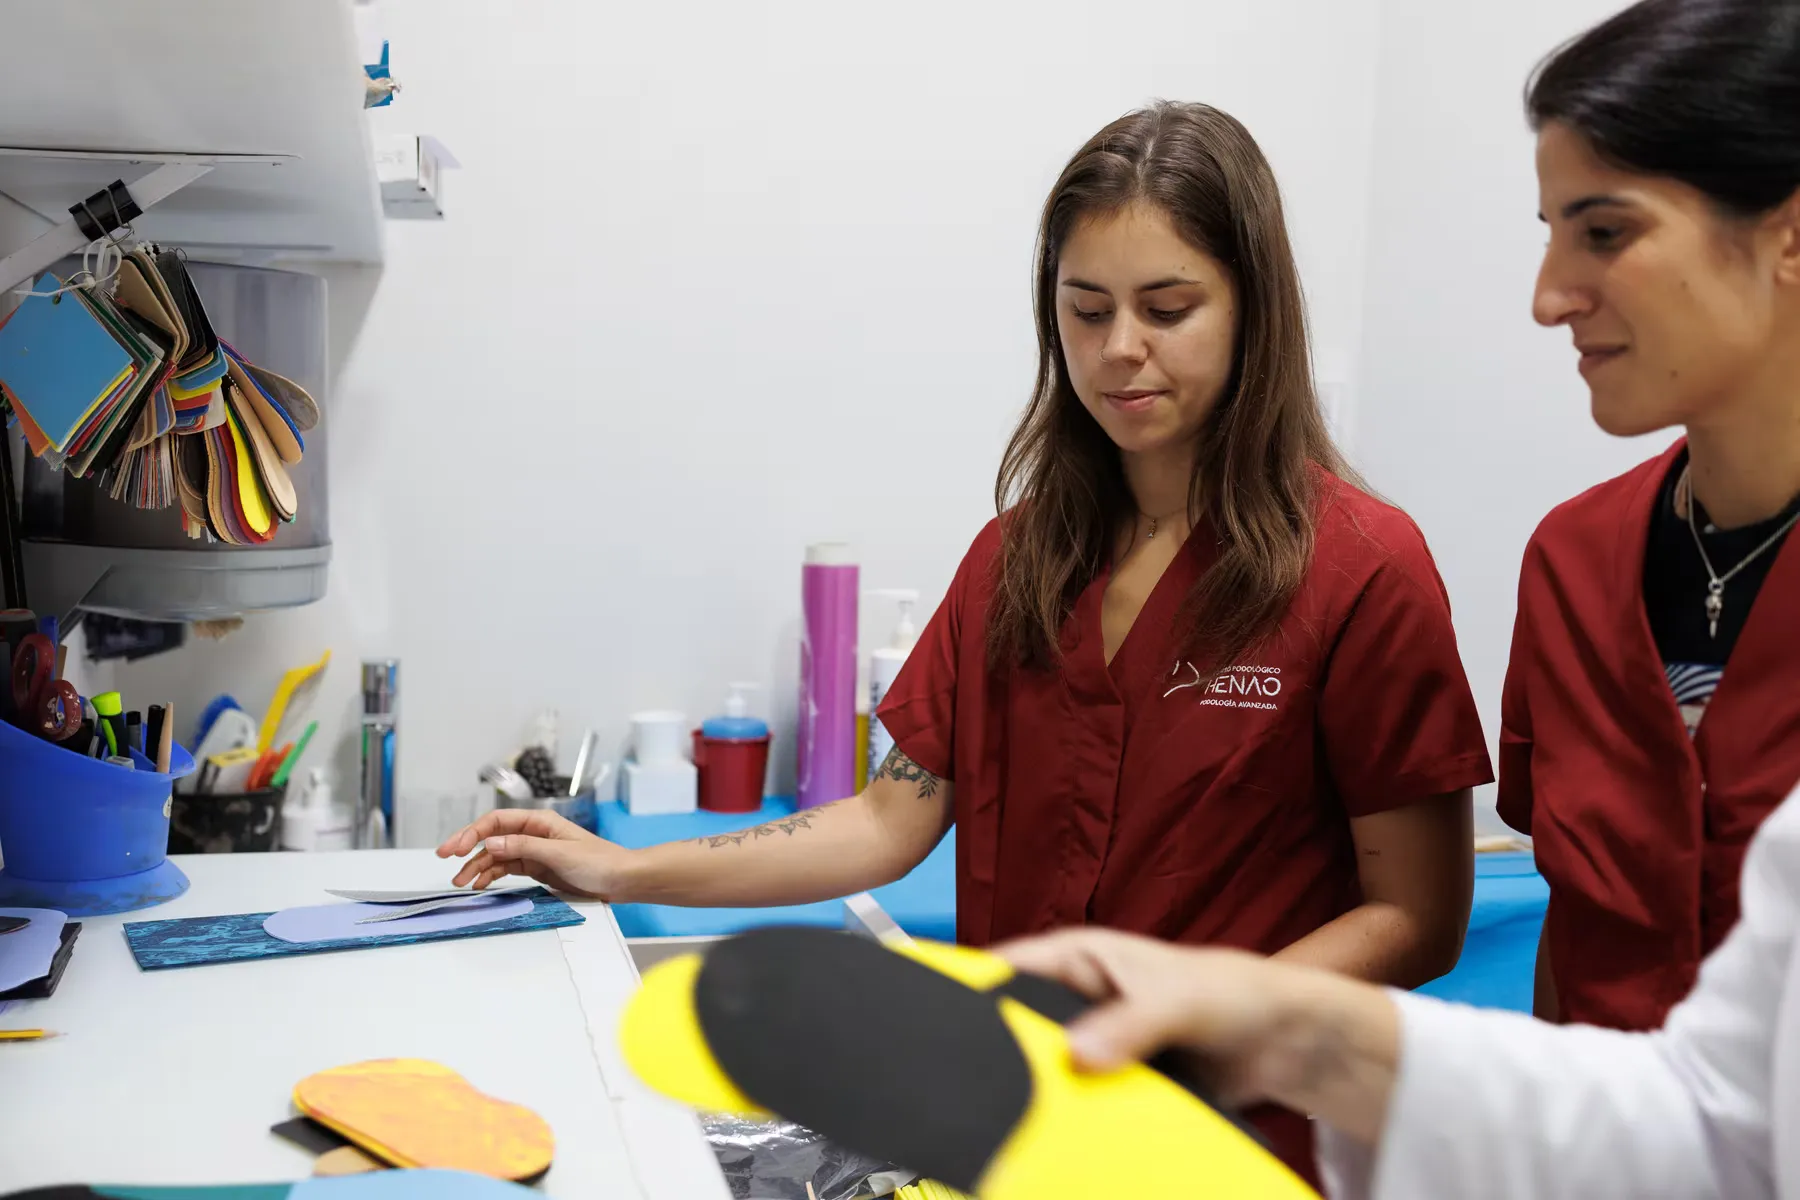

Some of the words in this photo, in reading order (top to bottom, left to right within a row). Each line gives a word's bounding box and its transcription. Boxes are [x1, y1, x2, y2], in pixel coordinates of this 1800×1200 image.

[1232, 665, 1281, 674] PODOLÓGICO
[1204, 674, 1281, 696] HENAO
[1238, 701, 1278, 710] AVANZADA
